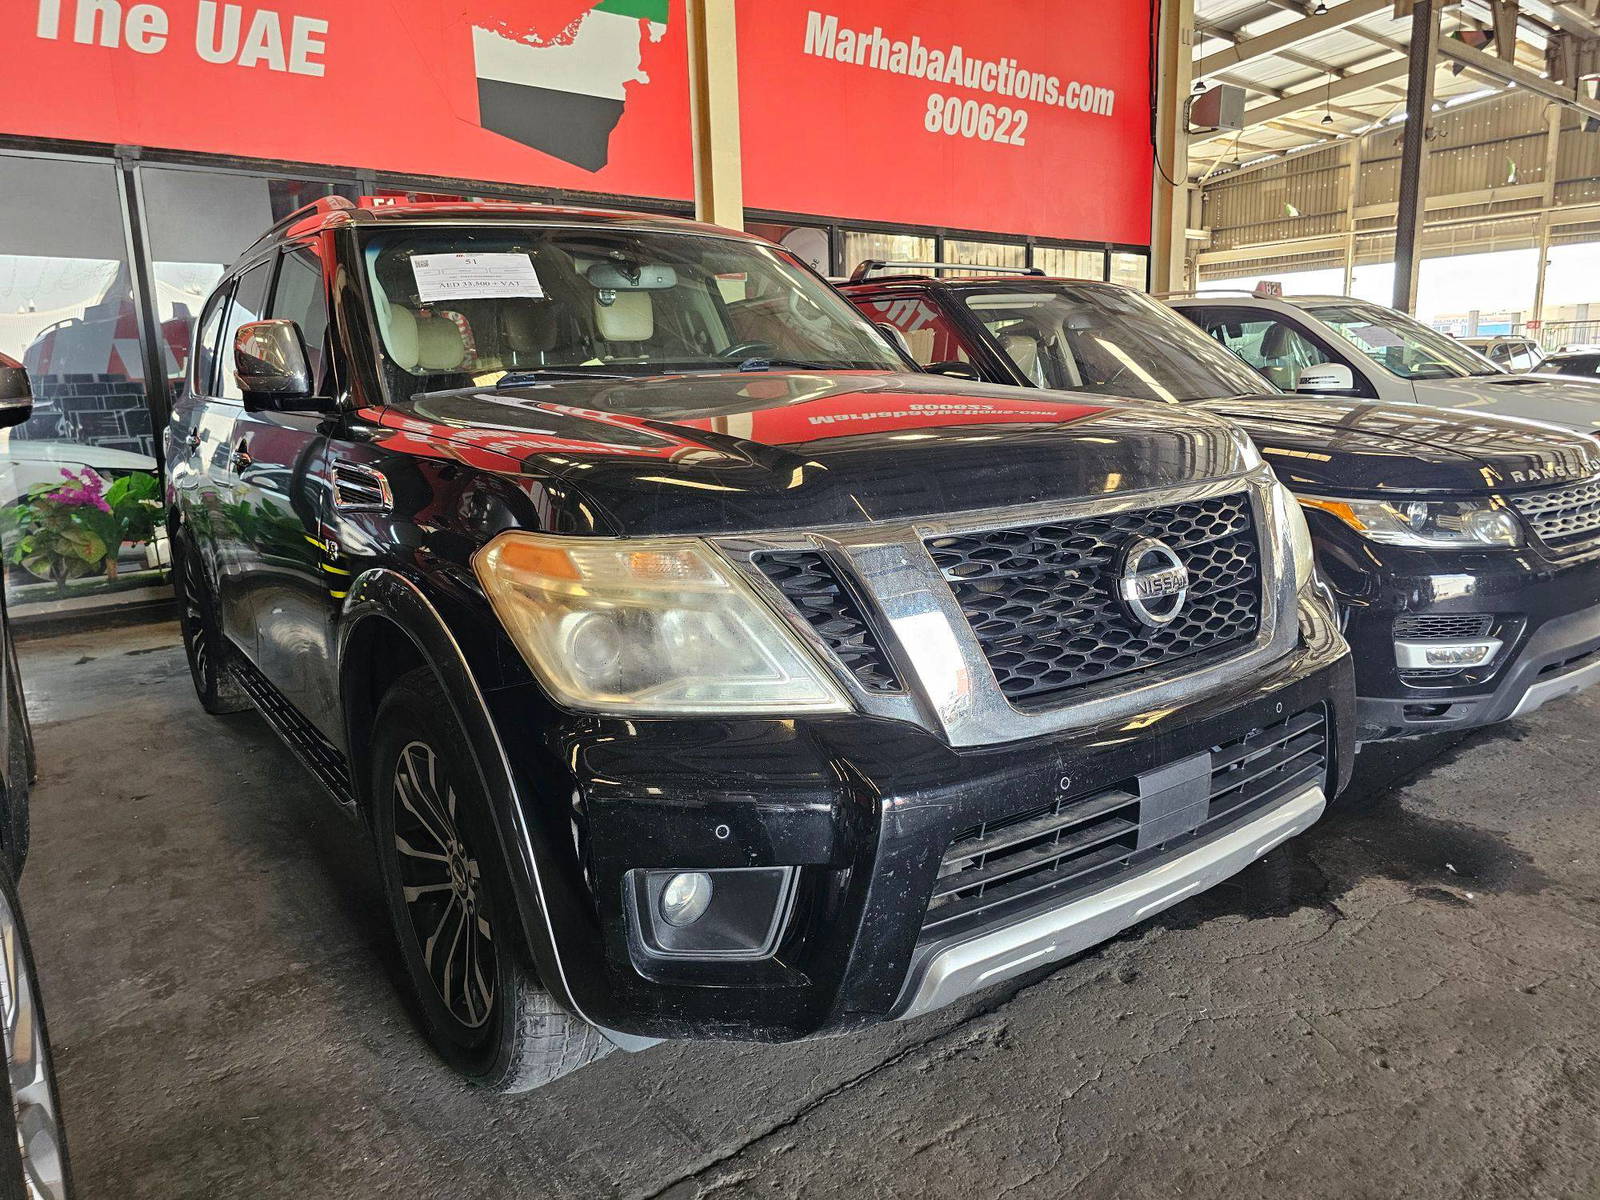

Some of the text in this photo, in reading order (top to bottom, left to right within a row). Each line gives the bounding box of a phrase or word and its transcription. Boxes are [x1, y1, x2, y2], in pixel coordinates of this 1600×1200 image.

[35, 0, 329, 78] The UAE
[803, 10, 1115, 116] MarhabaAuctions.com
[924, 93, 1028, 147] 800622
[440, 281, 460, 289] AED
[1510, 465, 1580, 483] RANGE
[1135, 575, 1188, 595] NISSAN
